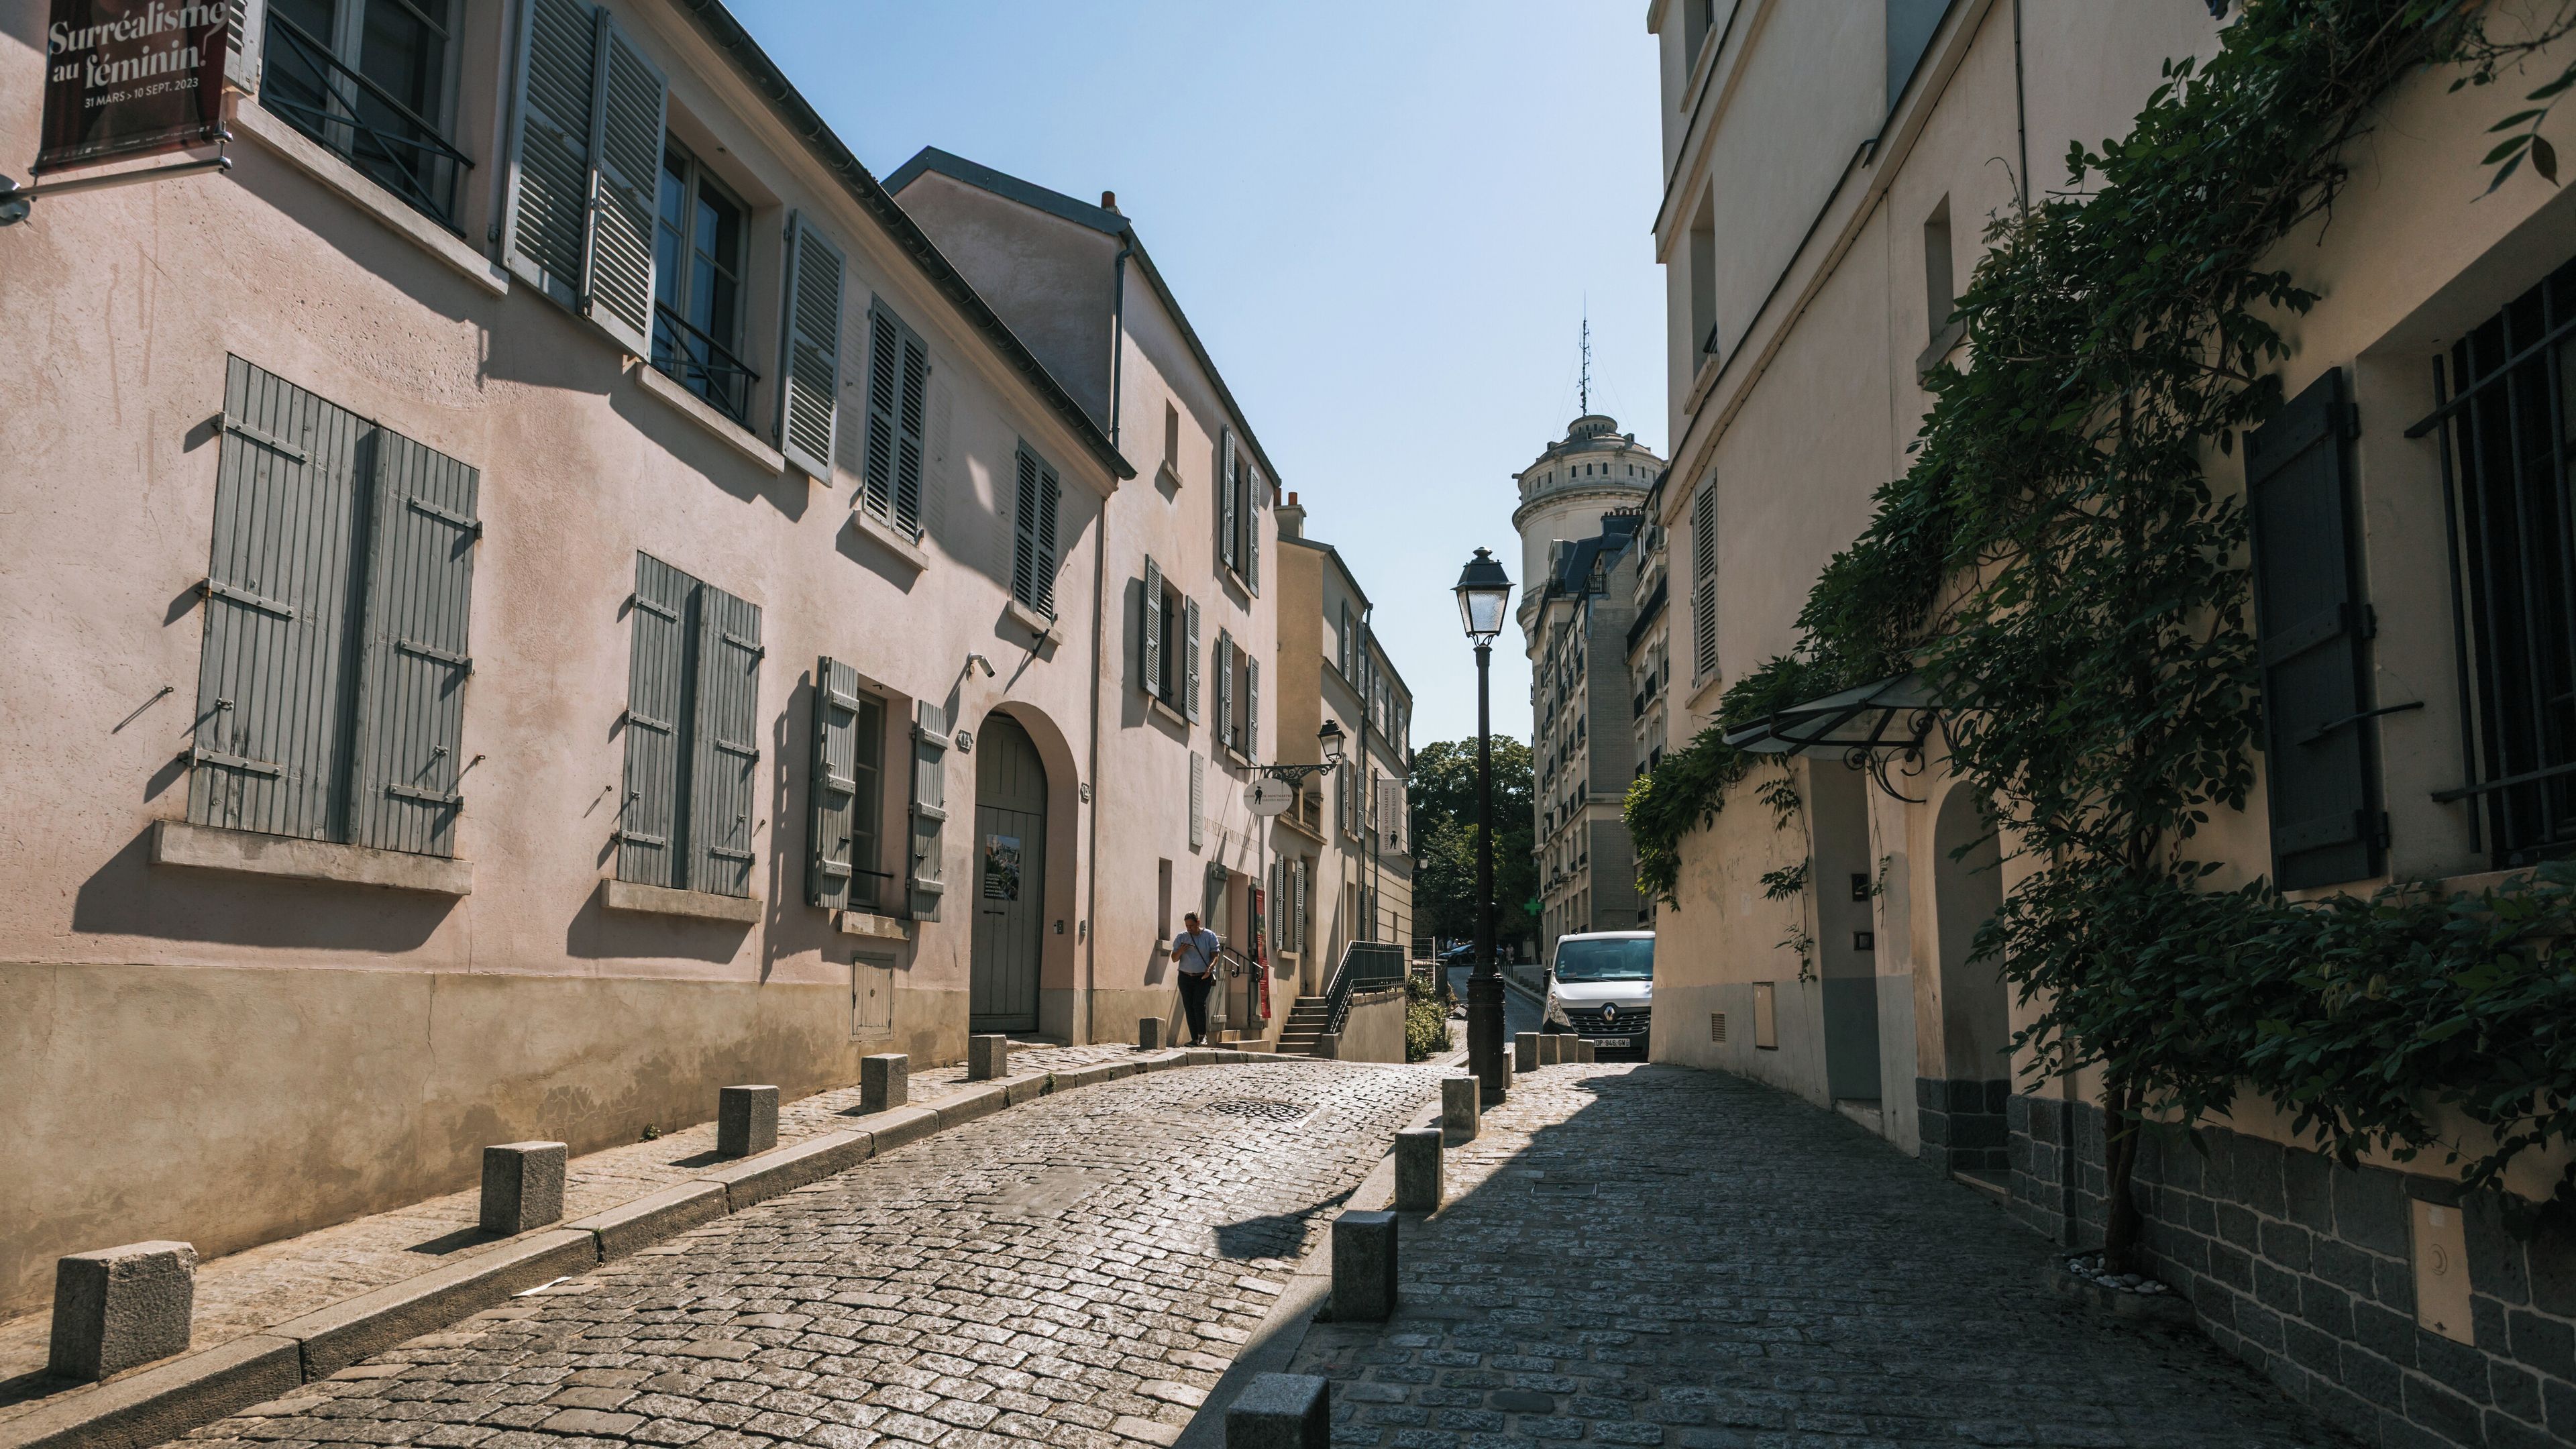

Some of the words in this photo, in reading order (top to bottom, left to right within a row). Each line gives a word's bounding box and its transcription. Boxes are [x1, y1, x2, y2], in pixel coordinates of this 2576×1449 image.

[49, 1, 227, 55] Surréalisme
[53, 62, 79, 82] au
[85, 98, 95, 108] 31
[97, 93, 125, 106] MARS
[134, 88, 144, 99] 10
[146, 83, 172, 96] SEPT.
[174, 77, 199, 91] 2023
